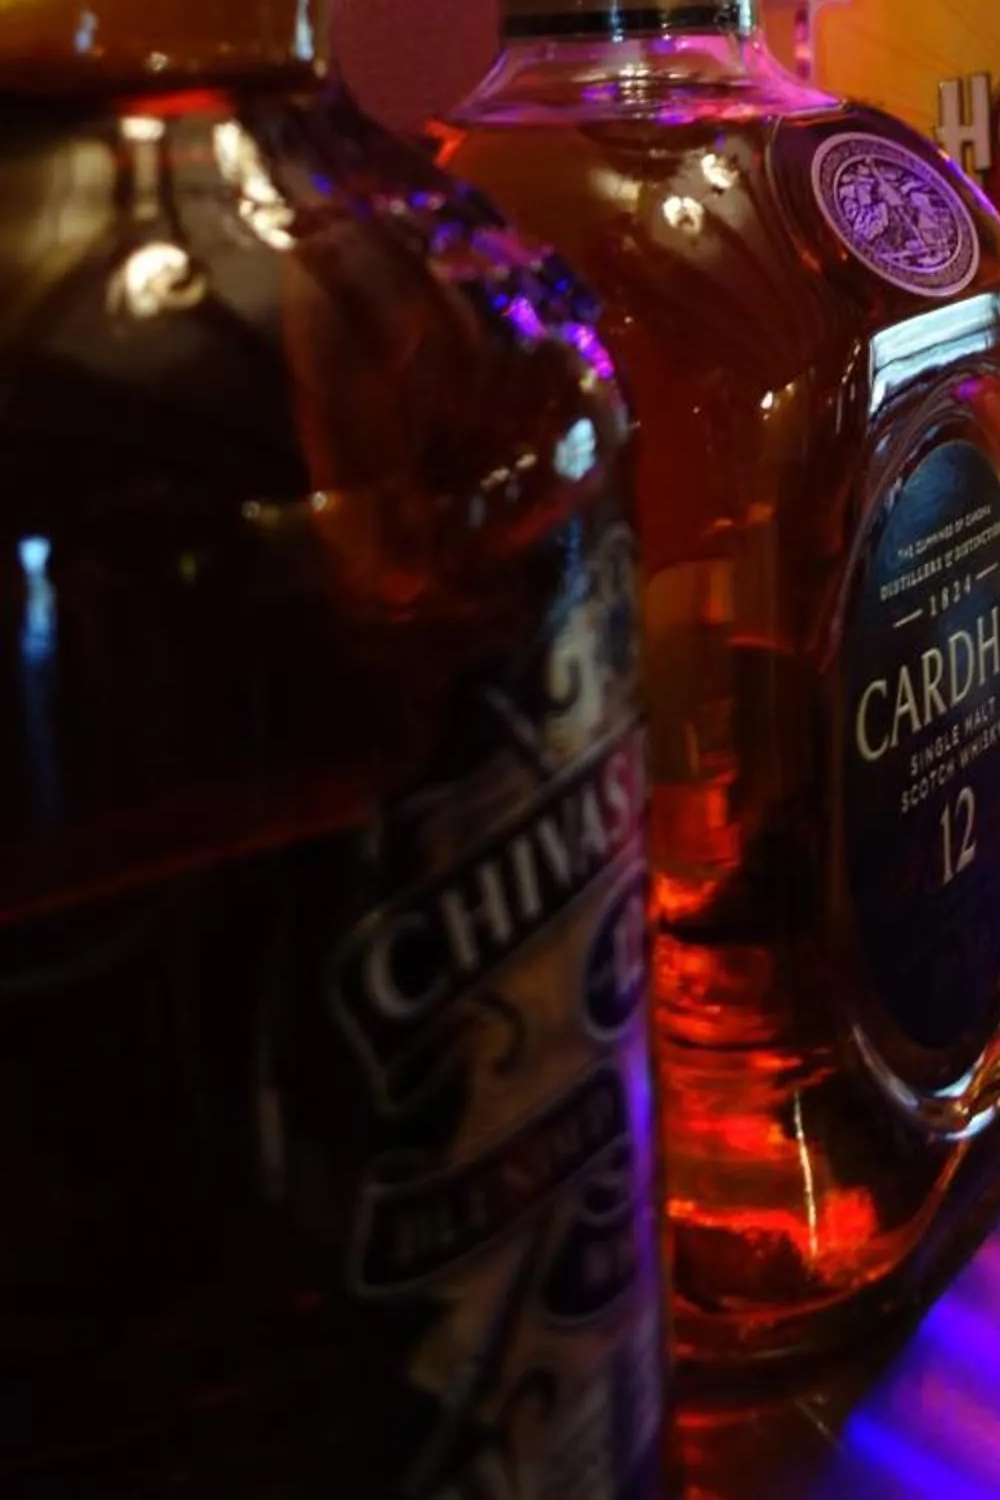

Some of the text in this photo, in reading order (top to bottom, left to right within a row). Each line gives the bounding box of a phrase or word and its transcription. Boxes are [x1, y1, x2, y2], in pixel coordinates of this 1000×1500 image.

[880, 556, 943, 602] DISTILLERS
[909, 695, 997, 777] SINGLE MALT
[900, 756, 955, 814] SCOTCH
[940, 785, 977, 885] 12
[360, 752, 634, 1017] CHIVAS
